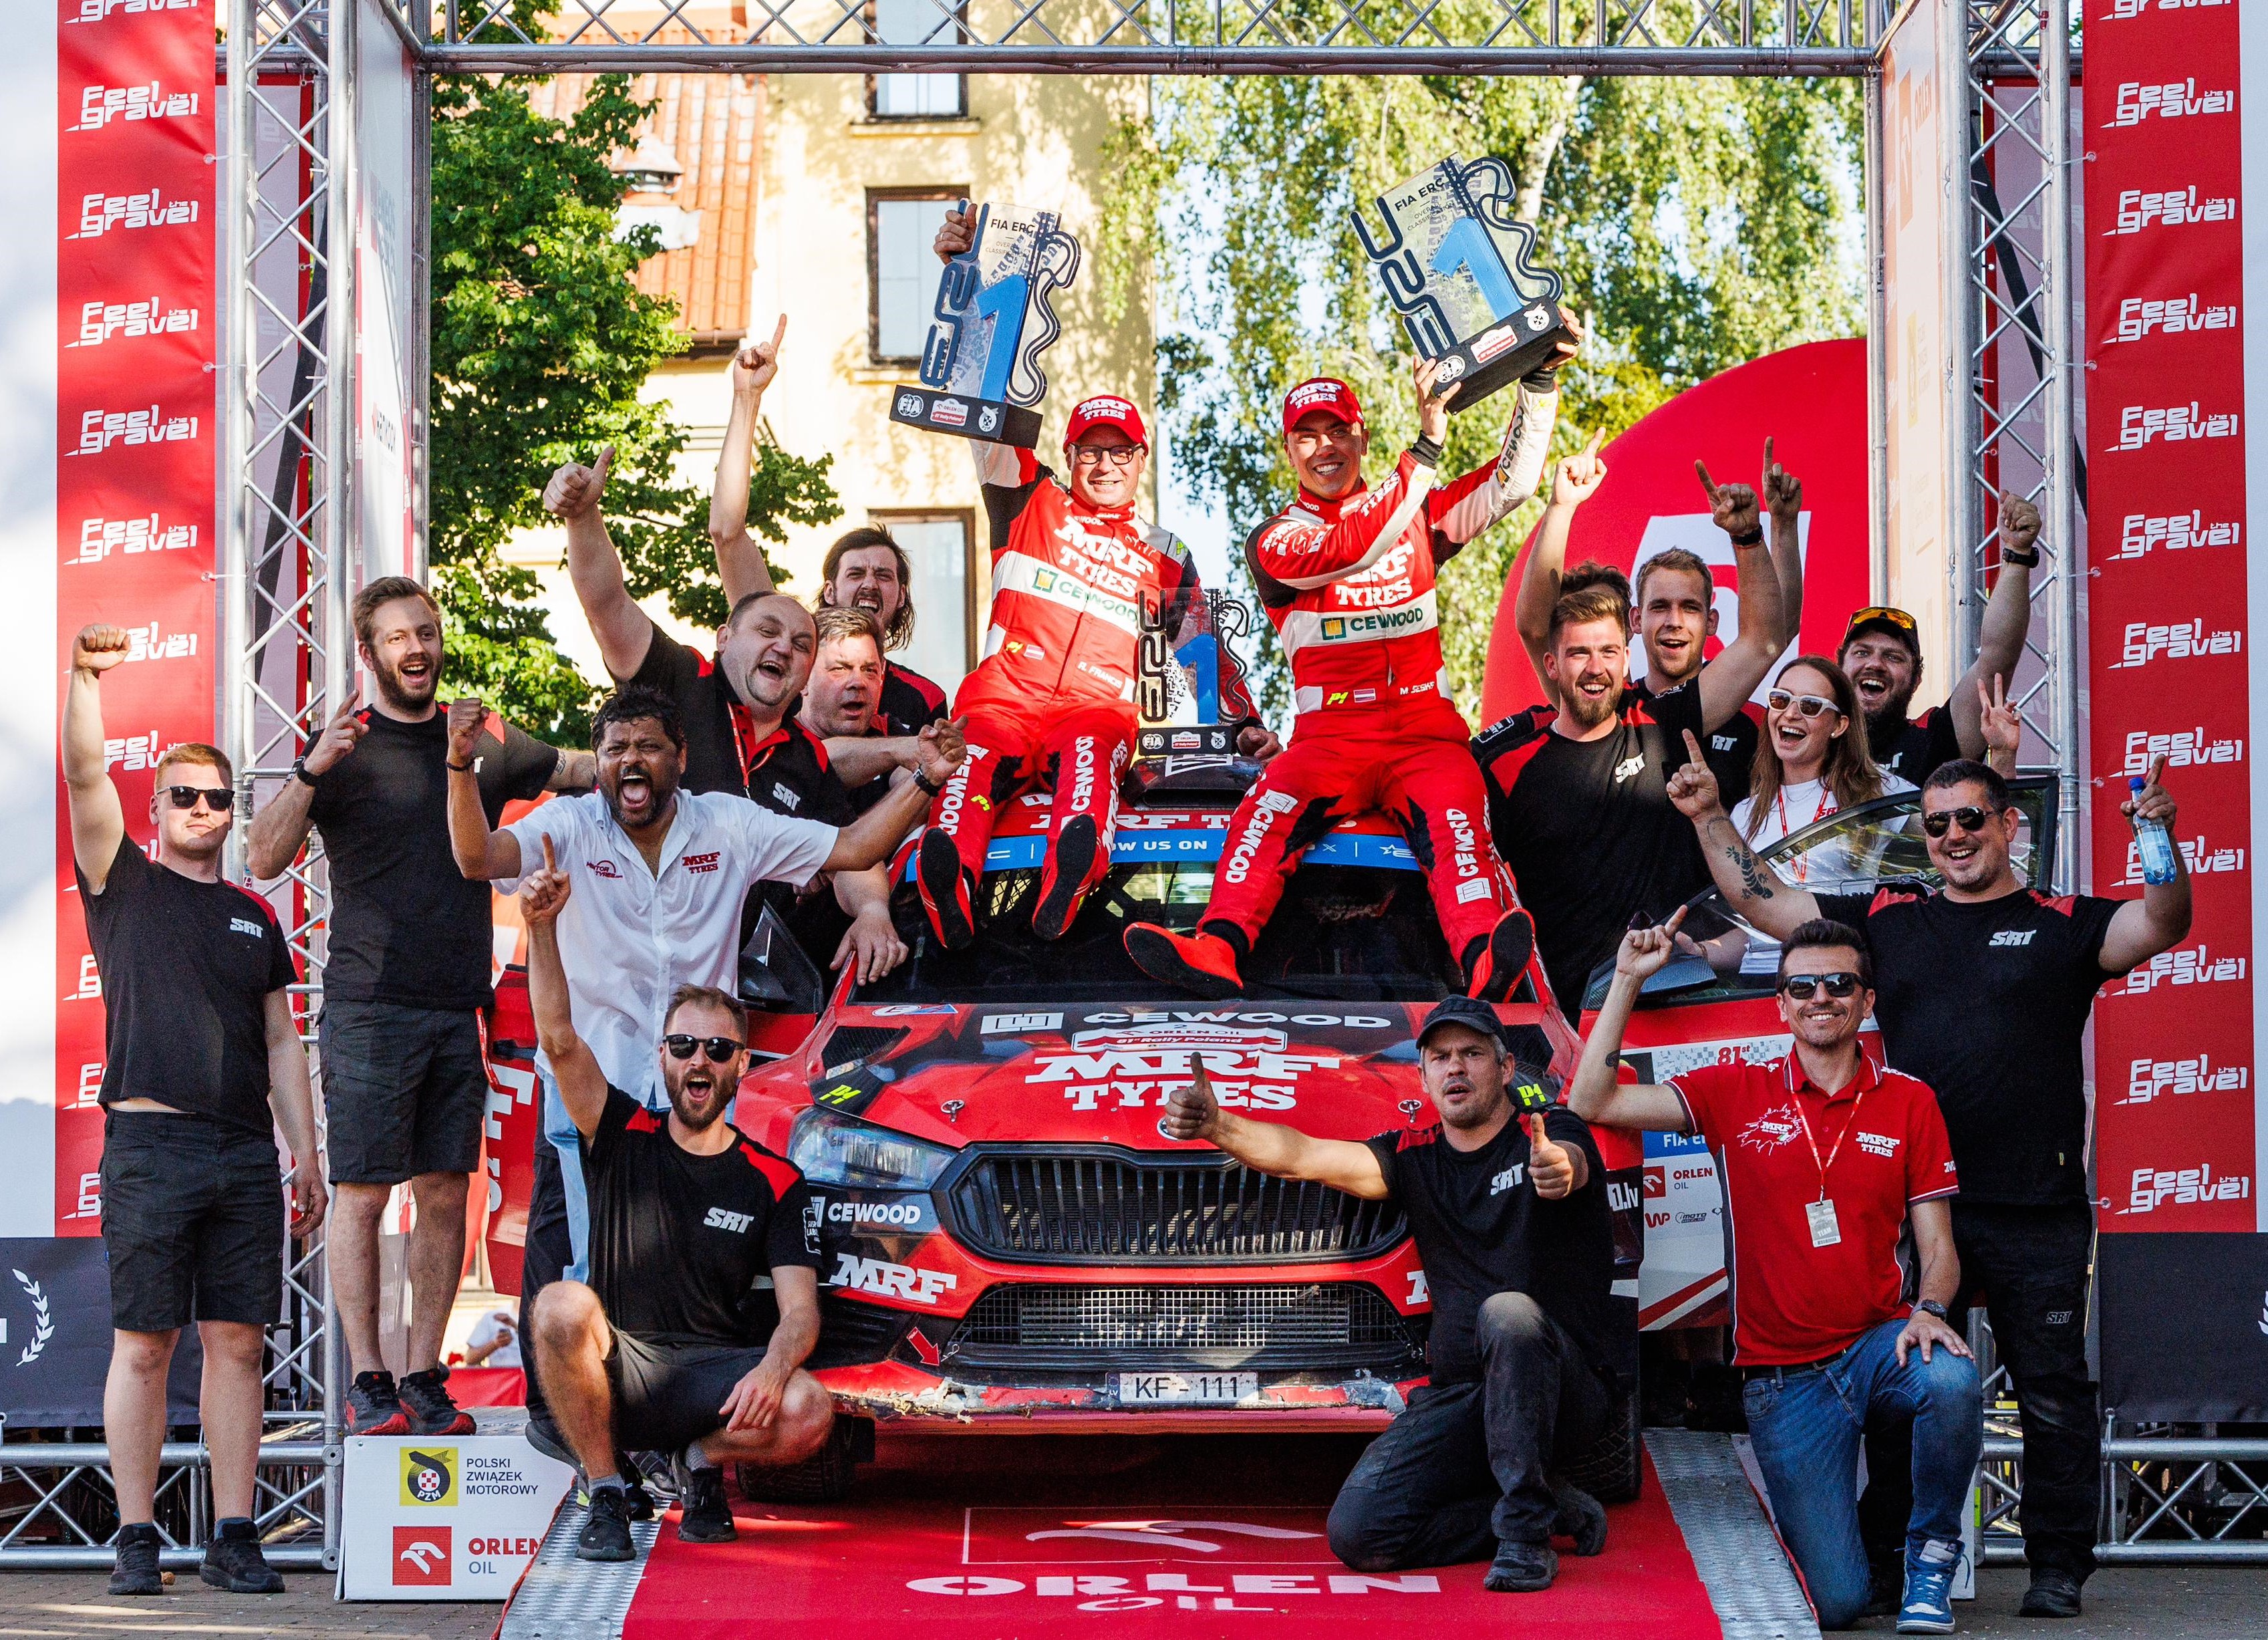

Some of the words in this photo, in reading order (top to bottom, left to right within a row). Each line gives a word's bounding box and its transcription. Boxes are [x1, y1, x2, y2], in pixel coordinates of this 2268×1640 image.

[82, 80, 158, 110] Feel
[2117, 78, 2195, 106] Feel
[80, 93, 198, 130] gravel
[2116, 91, 2234, 127] gravel
[82, 188, 158, 218] Feel
[1394, 194, 1417, 212] FIA
[1418, 177, 1445, 198] ERC
[2118, 185, 2196, 213] Feel
[80, 201, 198, 239] gravel
[1414, 202, 1442, 219] OVERALL
[2117, 198, 2235, 235] gravel
[990, 219, 1008, 231] FIA
[82, 296, 158, 325] Feel
[2119, 293, 2197, 321] Feel
[80, 309, 197, 346] gravel
[2118, 307, 2236, 343] gravel
[1079, 398, 1132, 415] MRF
[1290, 382, 1342, 404] MRF
[1295, 393, 1337, 409] TYRES
[82, 404, 158, 434] Feel
[1084, 408, 1126, 420] TYRES
[2121, 401, 2199, 429] Feel
[80, 417, 197, 454] gravel
[2120, 414, 2238, 450] gravel
[82, 513, 158, 542] Feel
[2122, 509, 2201, 537] Feel
[80, 525, 197, 563] gravel
[1054, 515, 1154, 577] MRF
[2121, 523, 2239, 559] gravel
[1058, 545, 1137, 597] TYRES
[1344, 541, 1415, 583] RF
[1058, 581, 1137, 622] CEWOOD
[1335, 577, 1413, 607] TYRES
[126, 622, 158, 645] el
[1350, 607, 1423, 632] CEWOOD
[2124, 618, 2203, 646] Feel
[124, 634, 197, 662] avel
[2123, 632, 2241, 668] gravel
[104, 730, 158, 757] eel
[1147, 736, 1162, 746] FIA
[2126, 726, 2204, 755] Feel
[1615, 752, 1645, 783] SRT
[772, 781, 801, 811] SRT
[1820, 807, 1838, 817] SR
[682, 851, 721, 866] MRF
[1143, 841, 1171, 851] US
[1179, 840, 1208, 849] ON
[688, 863, 718, 874] TYRES
[230, 917, 263, 938] SRT
[1989, 929, 2037, 946] SRT
[2150, 944, 2207, 970] eel
[2128, 958, 2246, 994] gravel
[1083, 1011, 1391, 1028] CEWOOD
[1141, 1037, 1181, 1045] Rally
[1717, 1045, 1751, 1065] 81st
[1024, 1051, 1340, 1083] MRF
[2130, 1054, 2209, 1082] Feel
[2129, 1067, 2247, 1103] gravel
[1663, 1134, 1688, 1147] FIA
[1760, 1121, 1793, 1132] MRF
[1856, 1131, 1900, 1149] MRF
[1861, 1143, 1893, 1157] TYRES
[1490, 1161, 1524, 1196] SRT
[1673, 1167, 1713, 1180] ORLEN
[2132, 1164, 2210, 1192] Feel
[2130, 1177, 2249, 1213] gravel
[704, 1206, 754, 1234] SRT
[827, 1203, 922, 1224] CEWOOD
[1817, 1226, 1832, 1237] TEAM
[829, 1252, 958, 1304] MRF
[2046, 1311, 2072, 1325] SRT
[1136, 1377, 1169, 1398] KF
[1201, 1376, 1239, 1398] 111
[466, 1458, 511, 1468] POLSKI
[466, 1472, 523, 1484] ZWIĄZEK
[466, 1485, 539, 1494] MOTOROWY
[417, 1490, 442, 1502] PZM
[469, 1561, 497, 1575] OIL
[905, 1573, 1440, 1596] ORLEN
[1077, 1597, 1273, 1612] OIL
